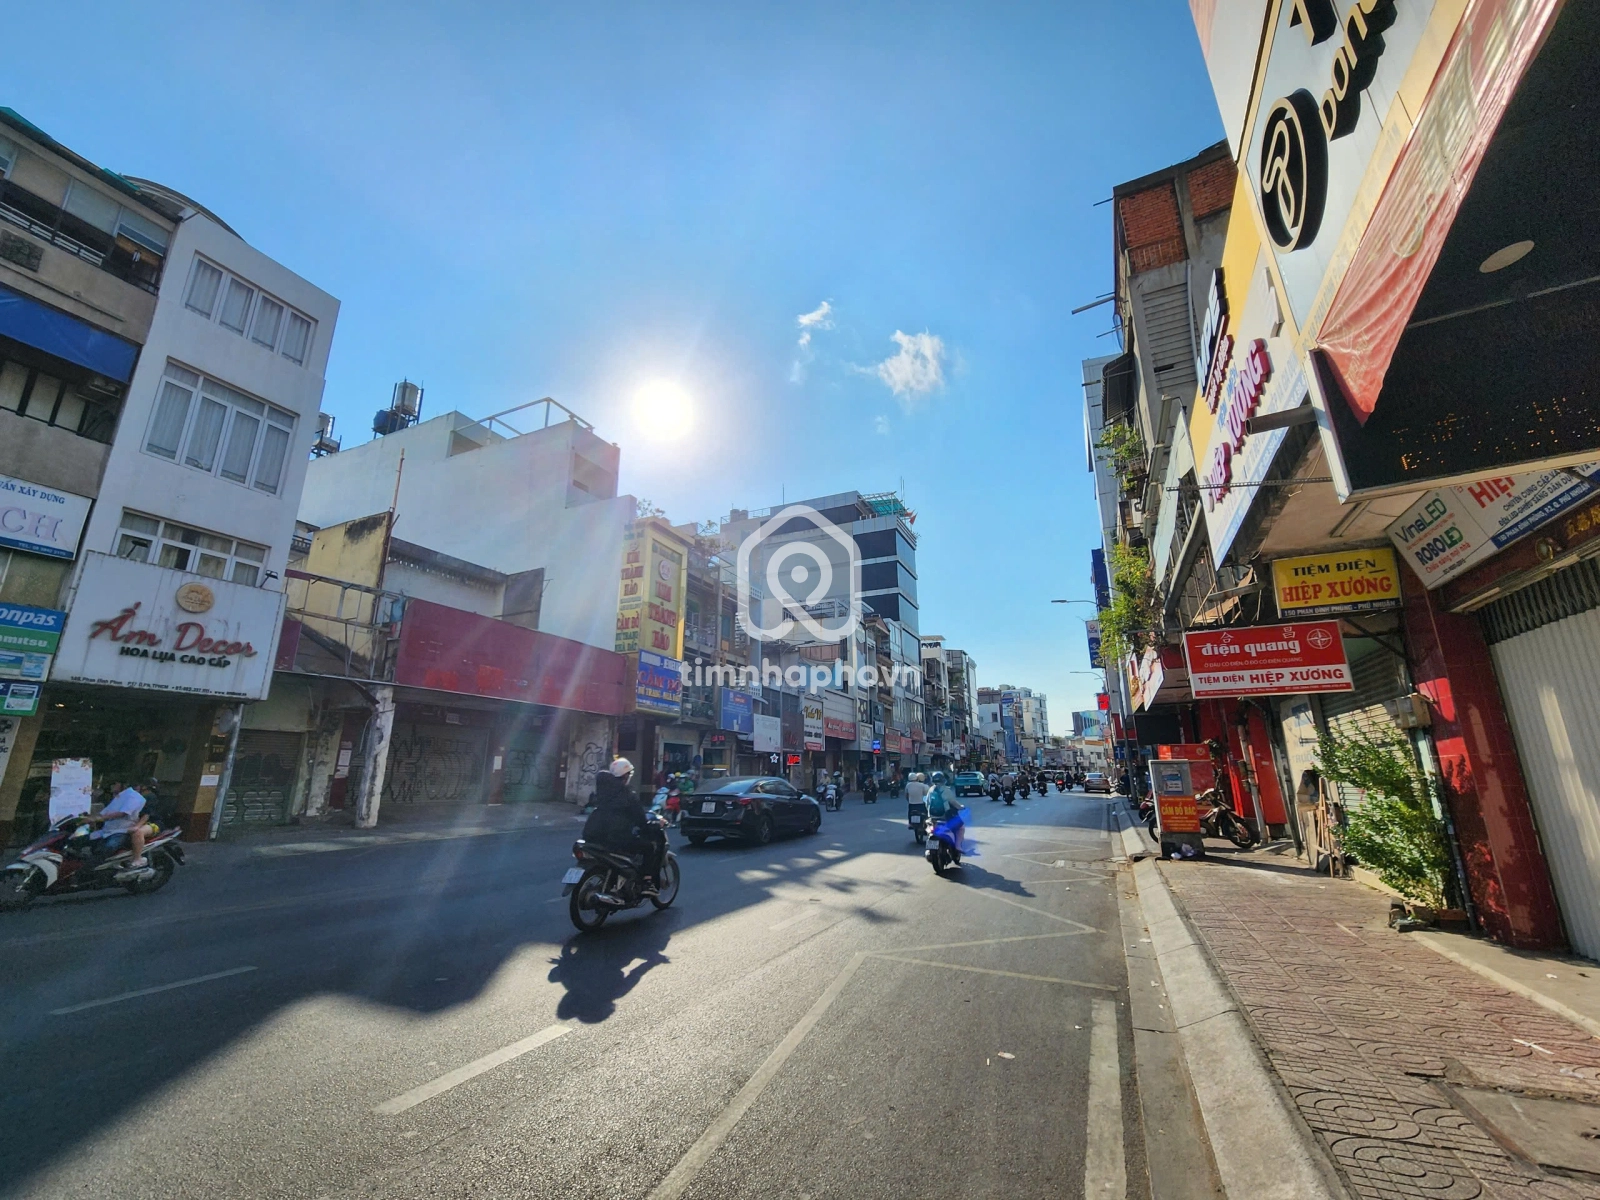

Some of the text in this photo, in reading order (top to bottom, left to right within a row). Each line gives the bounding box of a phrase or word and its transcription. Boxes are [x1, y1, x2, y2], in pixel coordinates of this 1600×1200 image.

[40, 491, 66, 505] DỰNG
[1521, 485, 1537, 499] CUNG
[1536, 473, 1551, 491] CẤP
[1395, 498, 1447, 543] VinaLED
[1414, 526, 1464, 566] ROBOLED
[1292, 558, 1377, 577] TIỆM ĐIỆN
[1282, 575, 1393, 605] HIỆP XƯƠNG
[174, 621, 258, 658] Decor
[1196, 640, 1301, 657] điện quang
[120, 645, 231, 669] HOA LỤA CAO CẤP
[1198, 668, 1345, 686] TIỆM ĐIỆN HIỆP XƯƠNG
